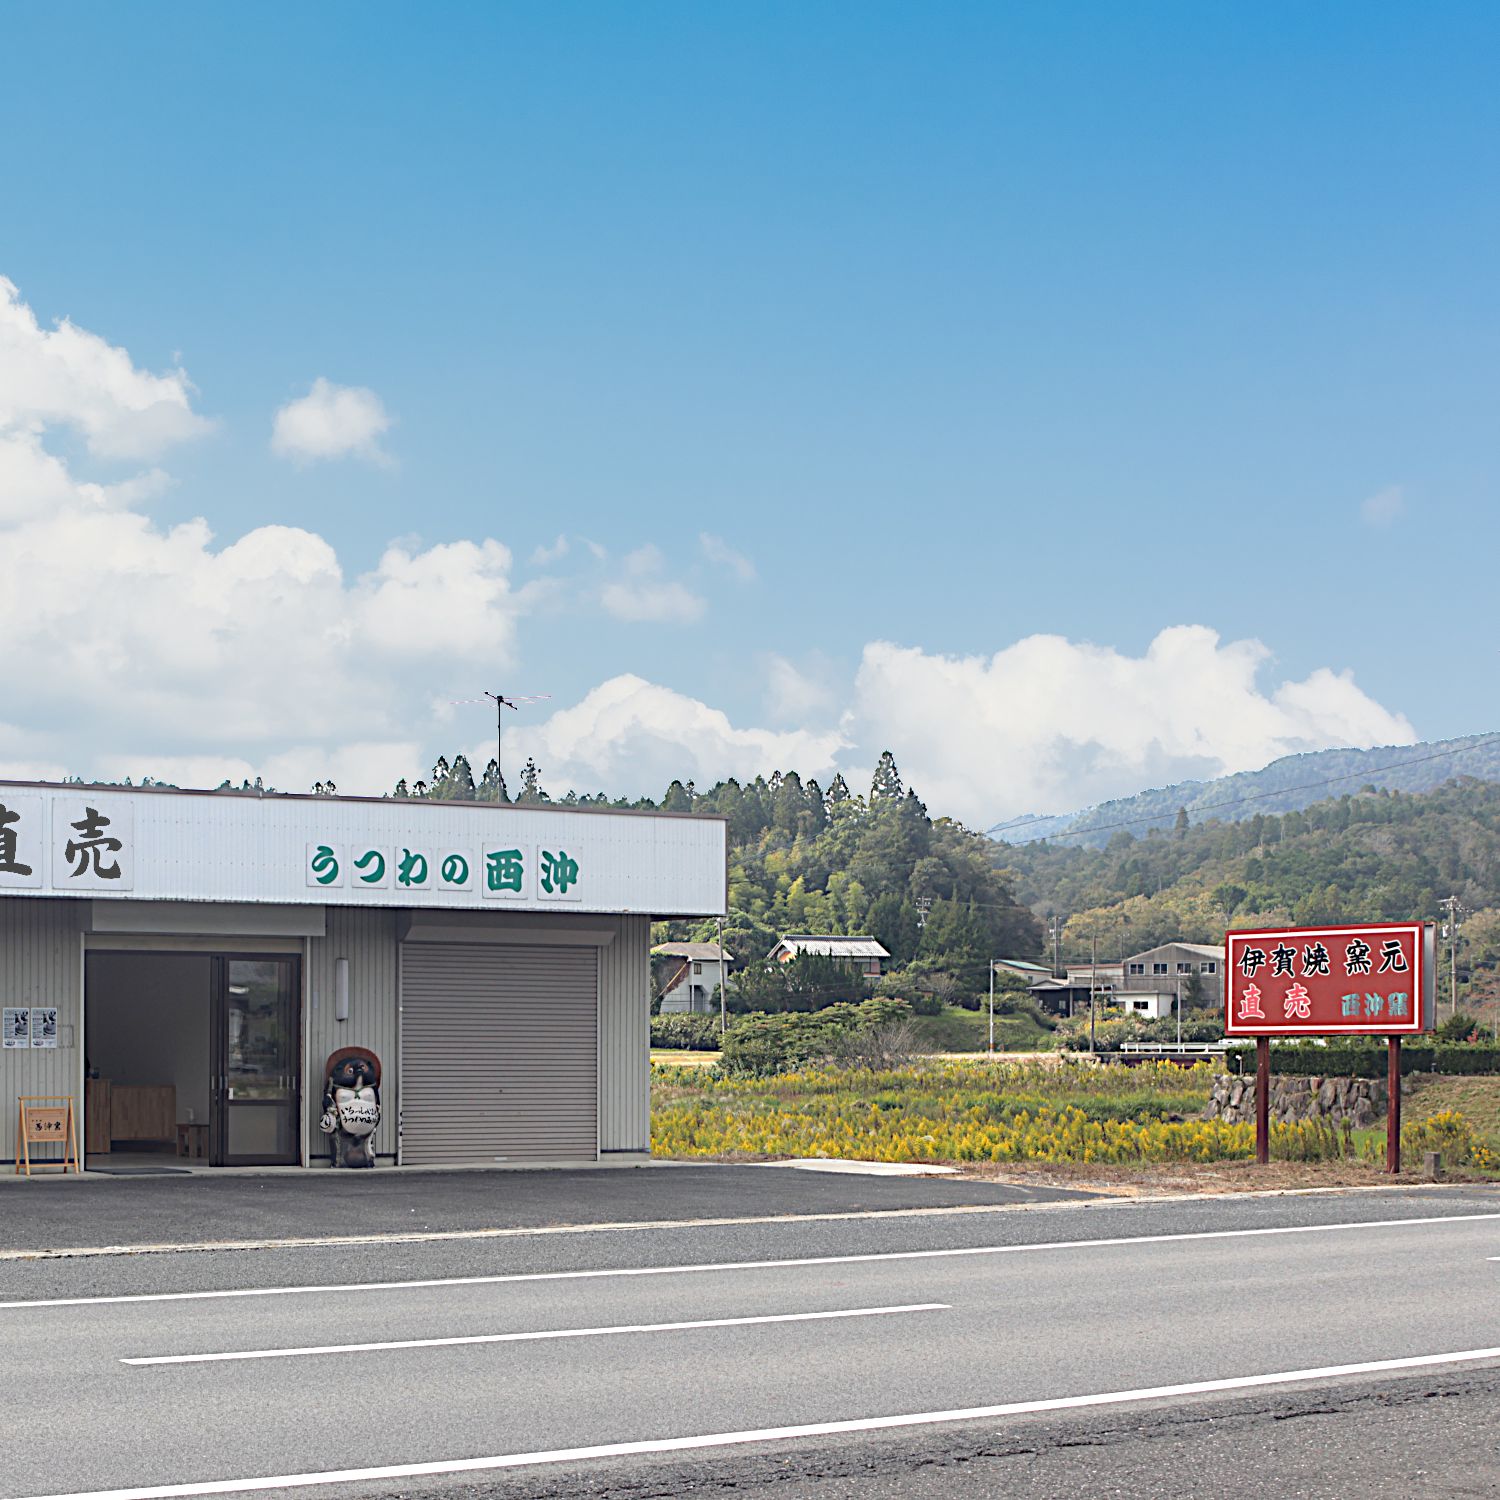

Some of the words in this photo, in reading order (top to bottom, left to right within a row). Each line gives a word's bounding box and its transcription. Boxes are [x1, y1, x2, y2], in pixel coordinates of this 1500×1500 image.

[311, 845, 580, 894] うつわの西沖
[1237, 942, 1330, 978] 伊賀焼
[1343, 938, 1409, 976] 窯元
[1238, 982, 1311, 1019] 直売
